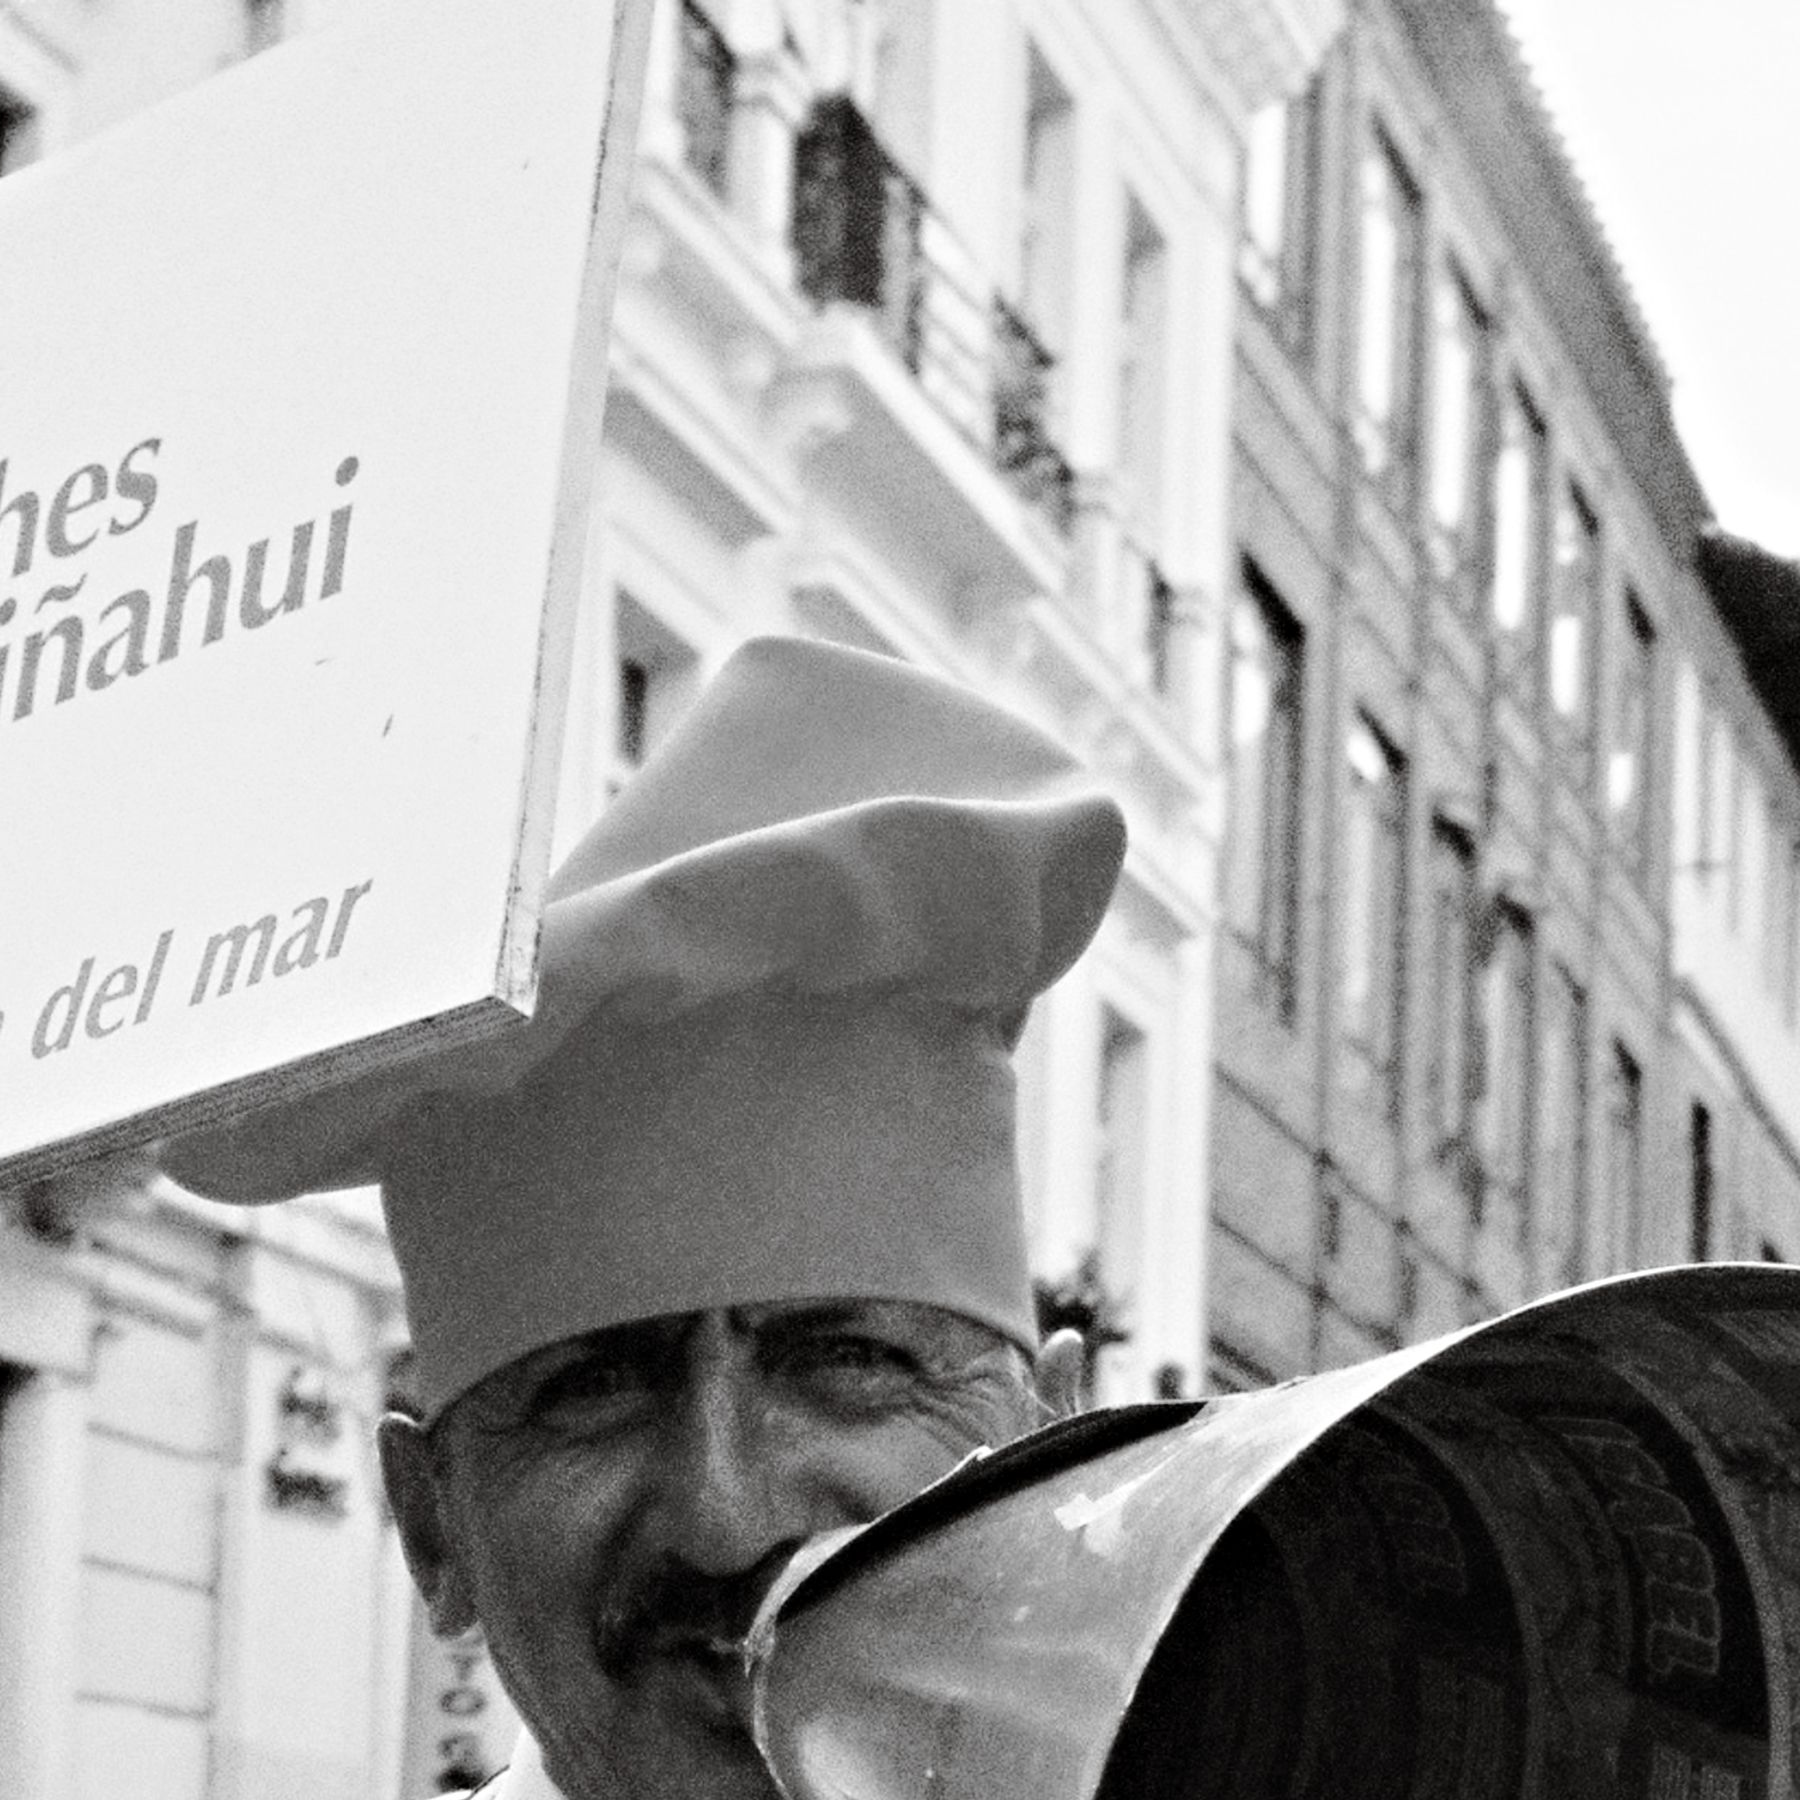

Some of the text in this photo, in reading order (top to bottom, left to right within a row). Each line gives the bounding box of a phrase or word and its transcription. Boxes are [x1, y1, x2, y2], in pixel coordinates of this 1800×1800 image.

[31, 929, 174, 1060] del
[188, 878, 374, 1007] mar
[1536, 1414, 1724, 1677] ISABEL
